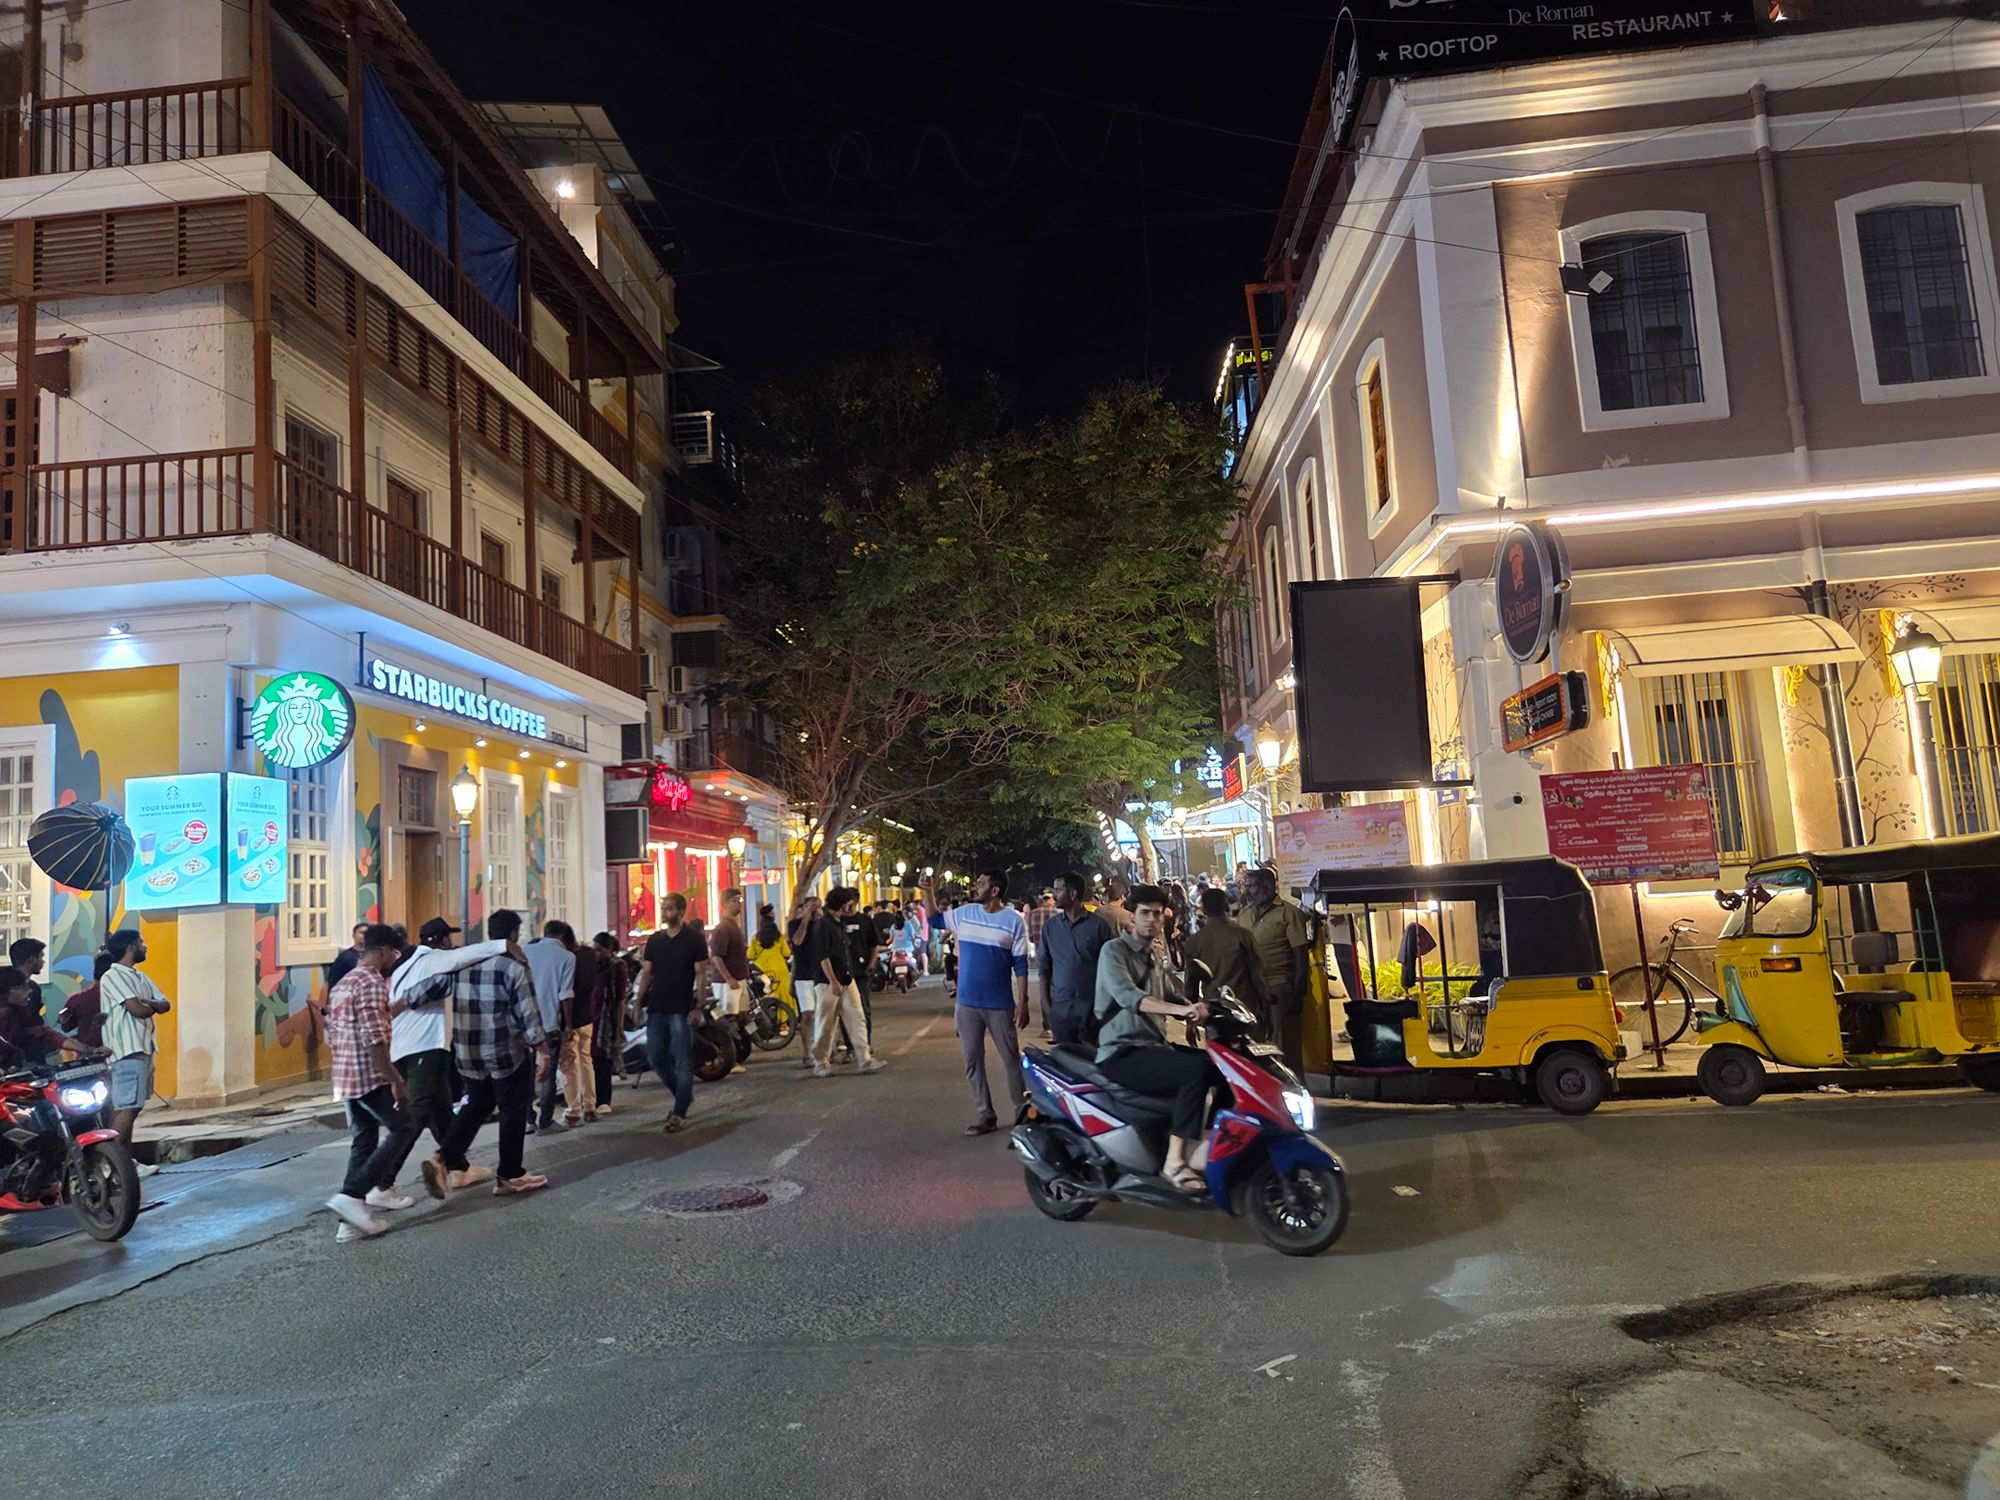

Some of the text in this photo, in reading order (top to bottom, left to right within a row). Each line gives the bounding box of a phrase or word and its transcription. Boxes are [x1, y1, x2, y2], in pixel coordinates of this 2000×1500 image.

[1508, 4, 1595, 26] De Roman
[1399, 11, 1713, 61] ROOFTOP RESTAURANT
[372, 658, 547, 739] STARBUCKS COFFEE
[161, 802, 191, 811] SUMMER
[1687, 791, 1708, 801] CITU
